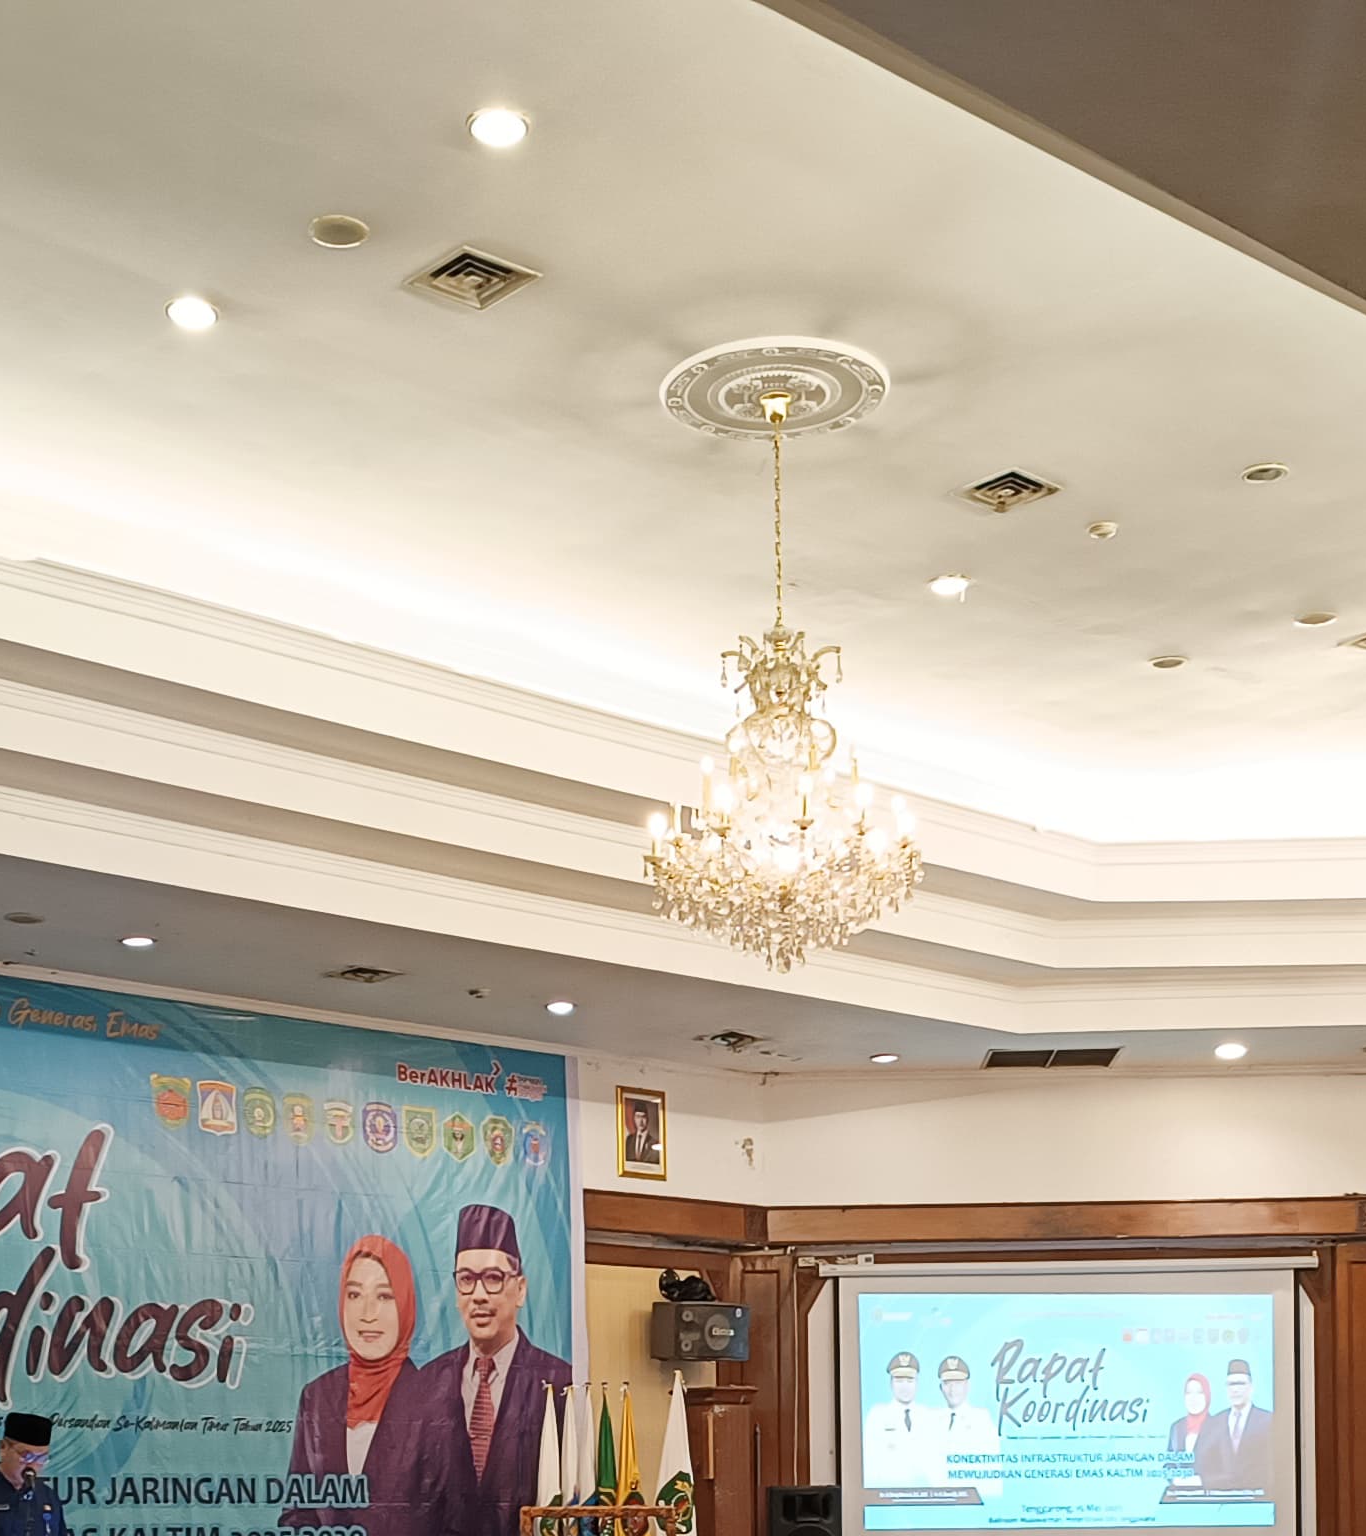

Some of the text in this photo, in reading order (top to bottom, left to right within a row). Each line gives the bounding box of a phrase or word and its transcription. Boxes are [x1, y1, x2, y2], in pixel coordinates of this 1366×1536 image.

[9, 998, 98, 1032] Generasi
[107, 1011, 159, 1040] Emas
[397, 1064, 496, 1093] BerAKHLAK
[991, 1339, 1106, 1401] Rapat
[265, 1420, 293, 1433] 2025
[998, 1386, 1149, 1436] Koordinasi
[105, 1477, 256, 1506] JARINGAN
[266, 1477, 367, 1504] DALAM
